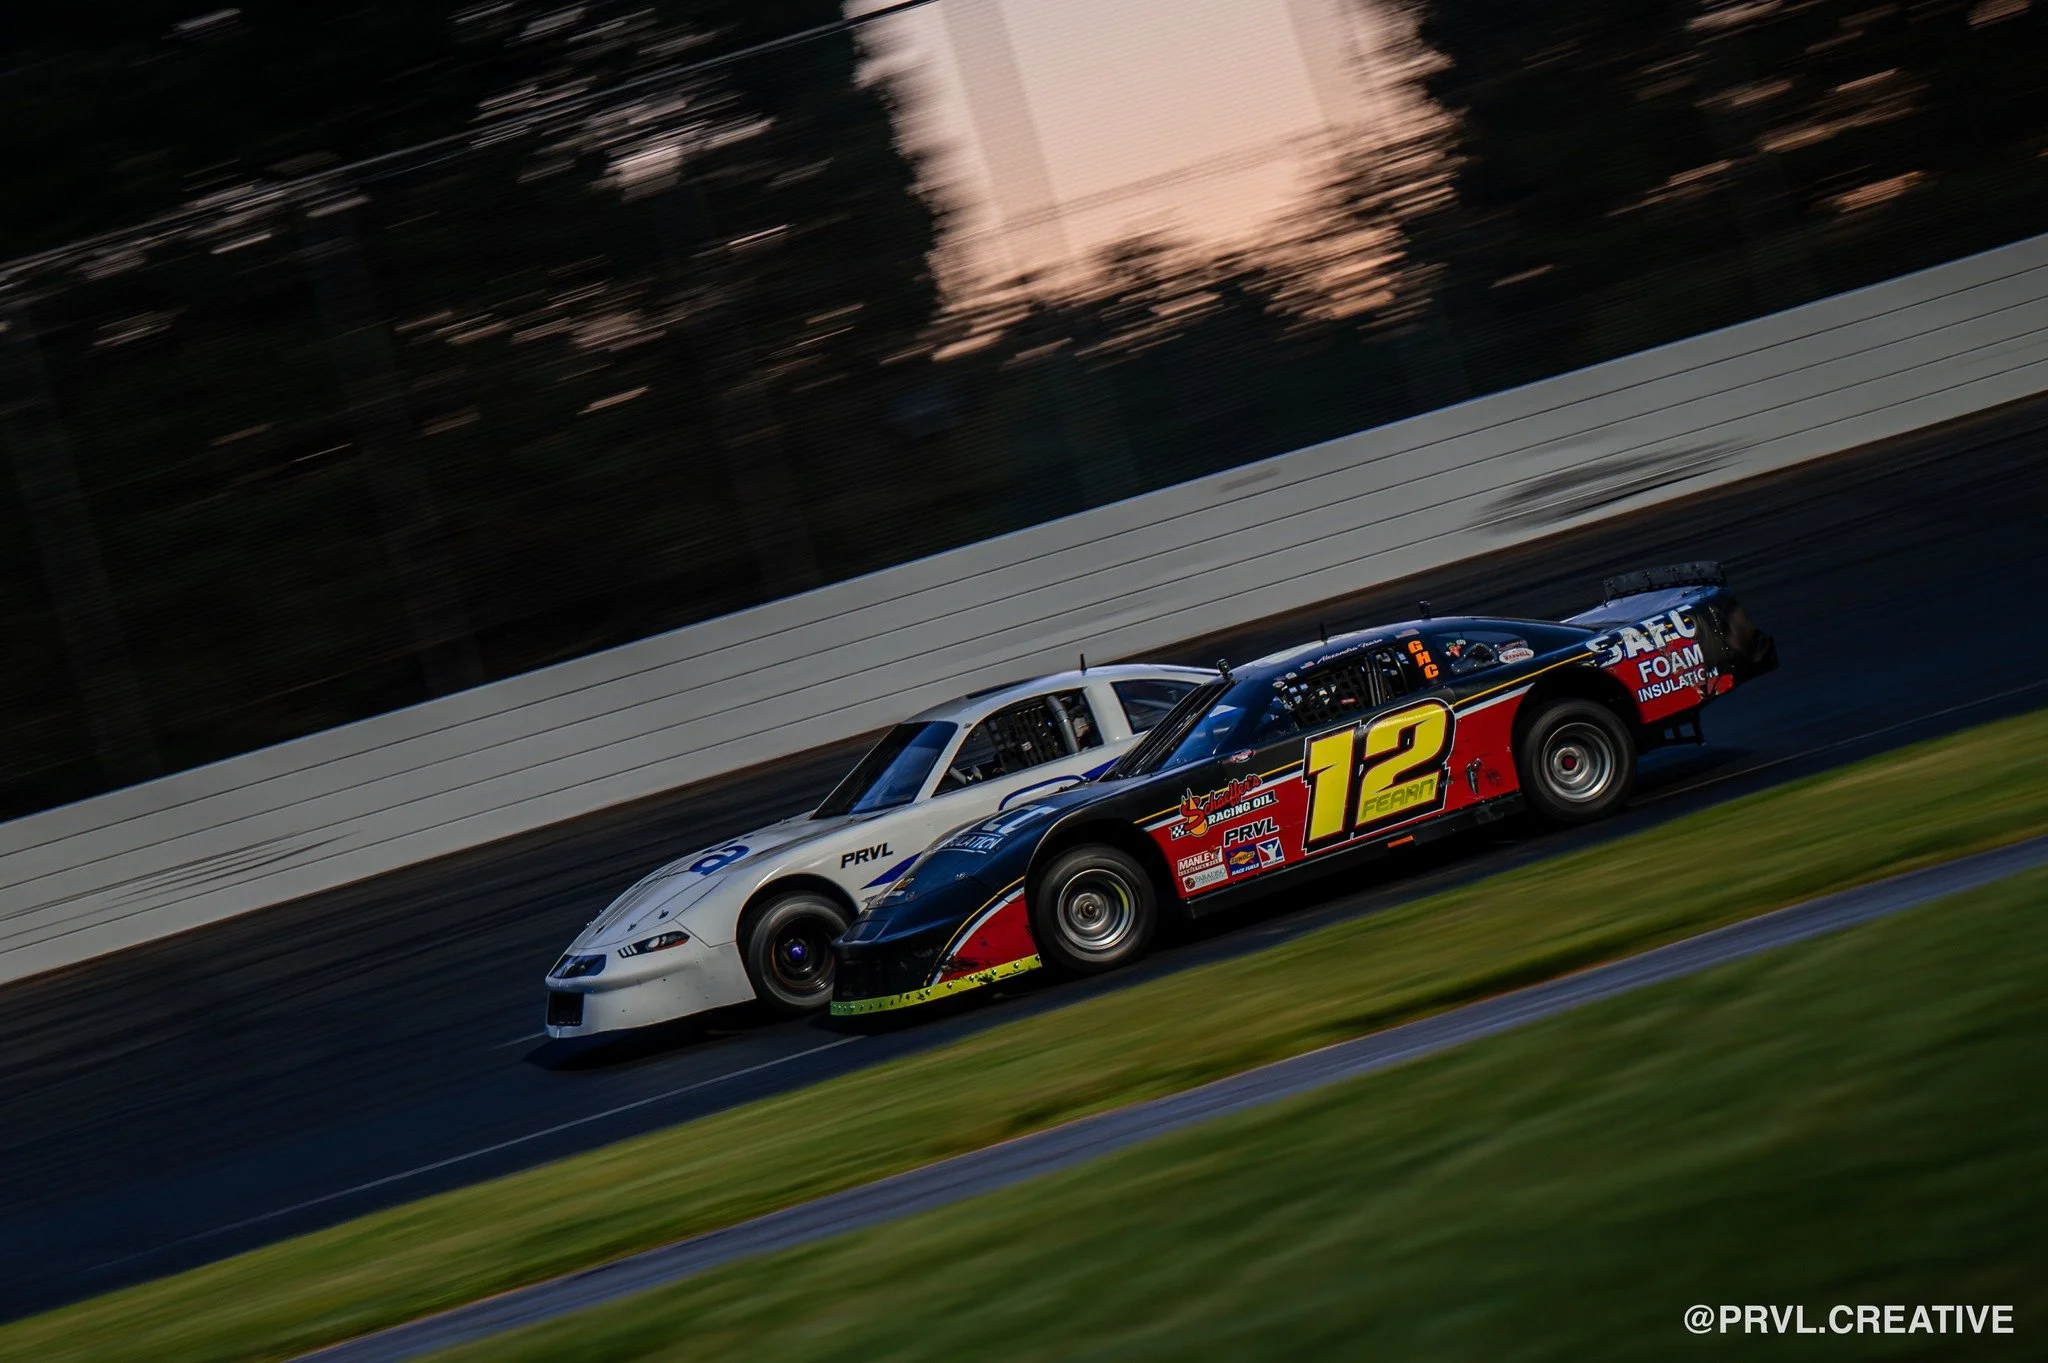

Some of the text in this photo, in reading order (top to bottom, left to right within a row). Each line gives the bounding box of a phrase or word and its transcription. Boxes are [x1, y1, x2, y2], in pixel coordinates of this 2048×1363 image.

[1408, 640, 1439, 679] GHC
[1638, 643, 1704, 683] FOAM
[1308, 701, 1450, 843] 12
[1207, 793, 1273, 825] RACING OIL
[1224, 818, 1279, 846] PRVL
[841, 842, 894, 869] PRVL
[1179, 850, 1217, 871] MANLEY
[1230, 851, 1255, 864] SUNOCO
